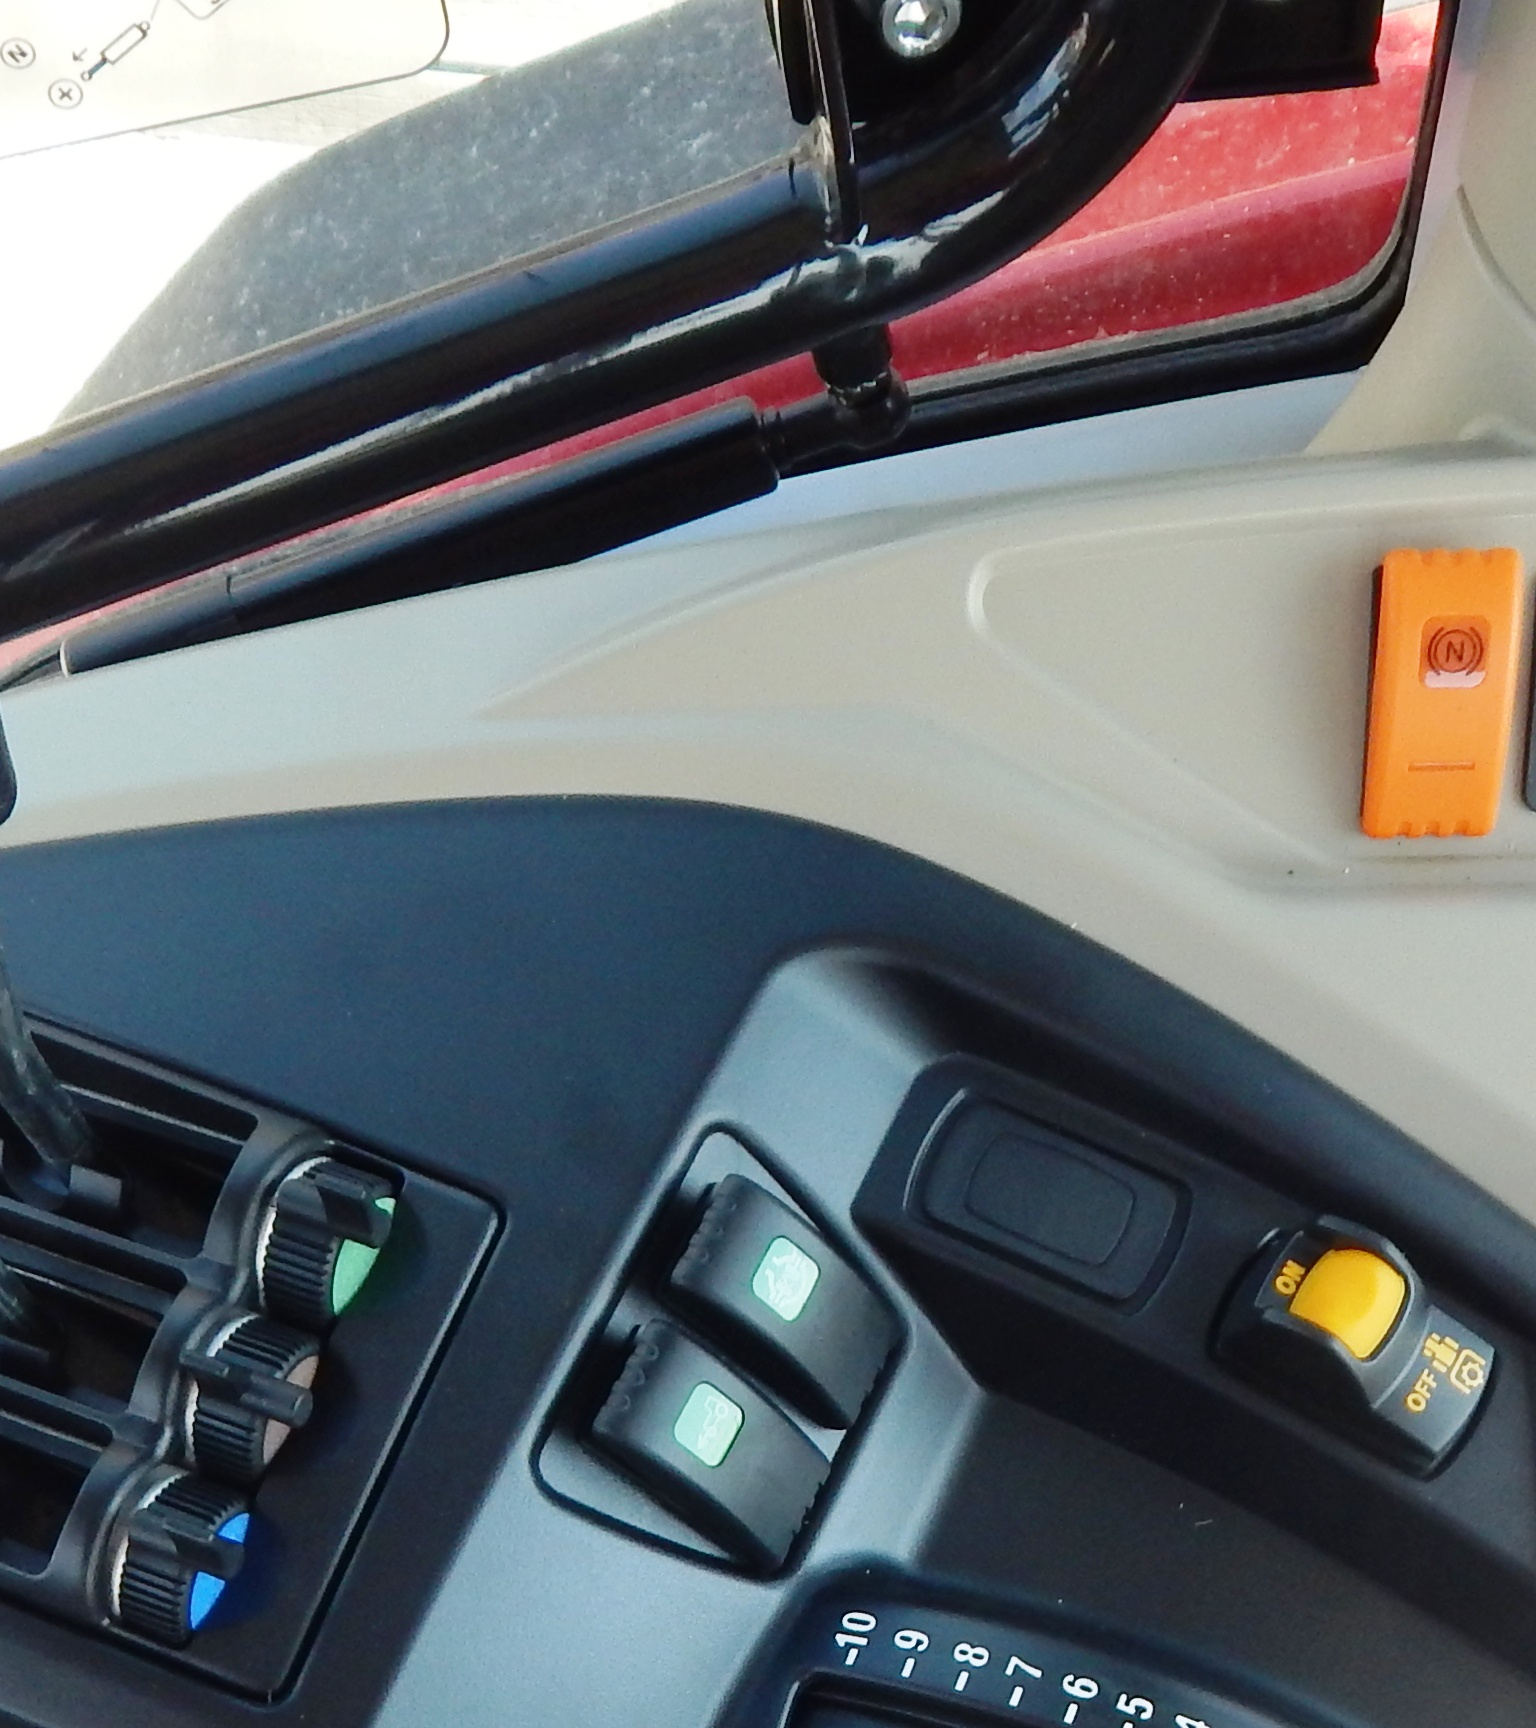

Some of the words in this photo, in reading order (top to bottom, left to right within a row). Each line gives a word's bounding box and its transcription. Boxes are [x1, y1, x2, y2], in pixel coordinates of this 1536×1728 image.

[1446, 640, 1465, 663] N
[1275, 1258, 1307, 1297] ON
[1406, 1368, 1438, 1415] OFF
[834, 1611, 877, 1648] 10
[894, 1629, 929, 1653] 9
[953, 1642, 990, 1667] 8
[1004, 1655, 1043, 1679] 7
[1063, 1673, 1100, 1700] 6
[1115, 1693, 1154, 1721] 5
